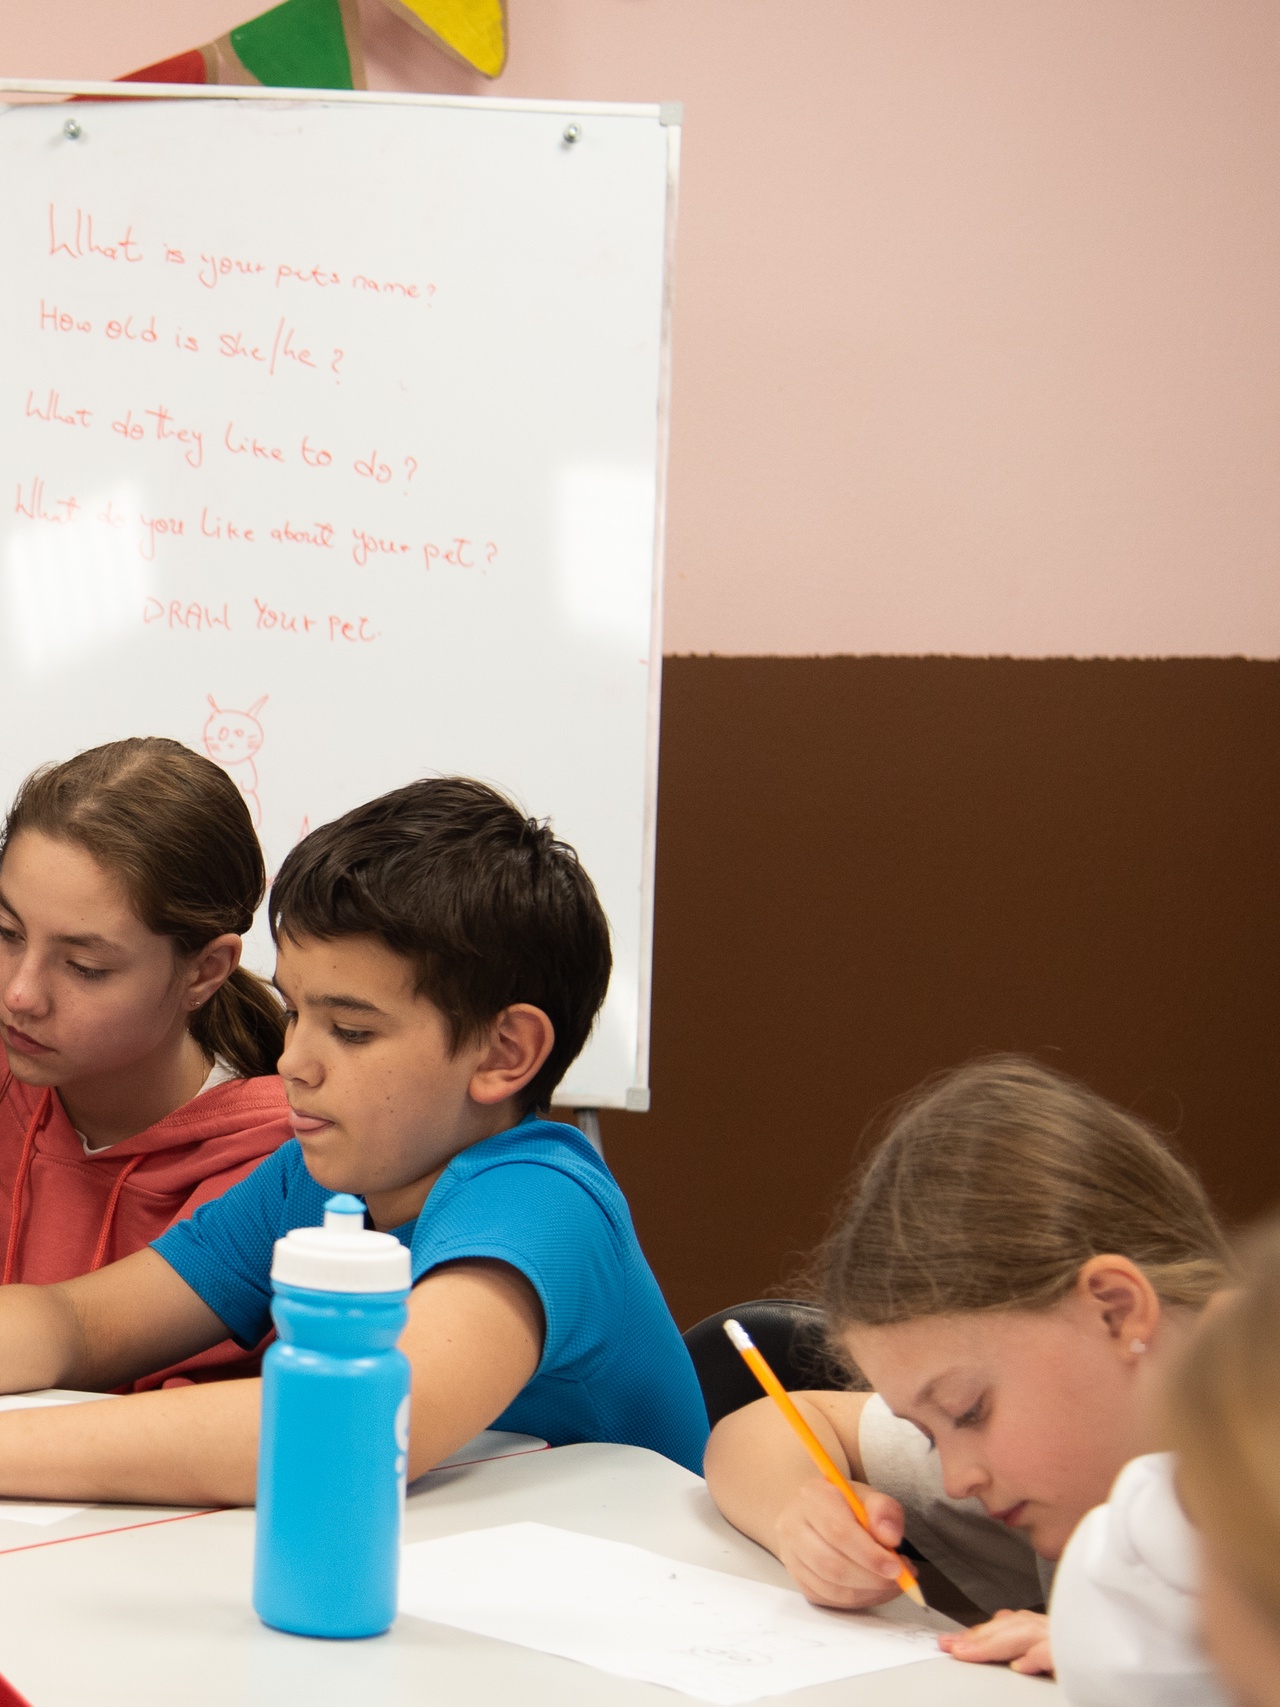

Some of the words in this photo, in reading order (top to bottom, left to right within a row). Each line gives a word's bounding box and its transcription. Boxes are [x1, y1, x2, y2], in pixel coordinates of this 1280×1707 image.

[48, 202, 144, 262] What
[163, 243, 186, 265] is
[198, 252, 265, 289] your
[38, 299, 92, 333] How
[105, 314, 158, 344] old
[175, 326, 200, 353] is
[25, 388, 92, 429] What
[112, 410, 145, 440] do
[224, 421, 286, 463] like
[302, 435, 333, 468] to
[14, 475, 80, 524] What
[138, 512, 185, 562] you
[201, 506, 255, 543] like
[270, 521, 336, 549] about
[352, 527, 411, 566] your
[142, 596, 233, 632] DRAW
